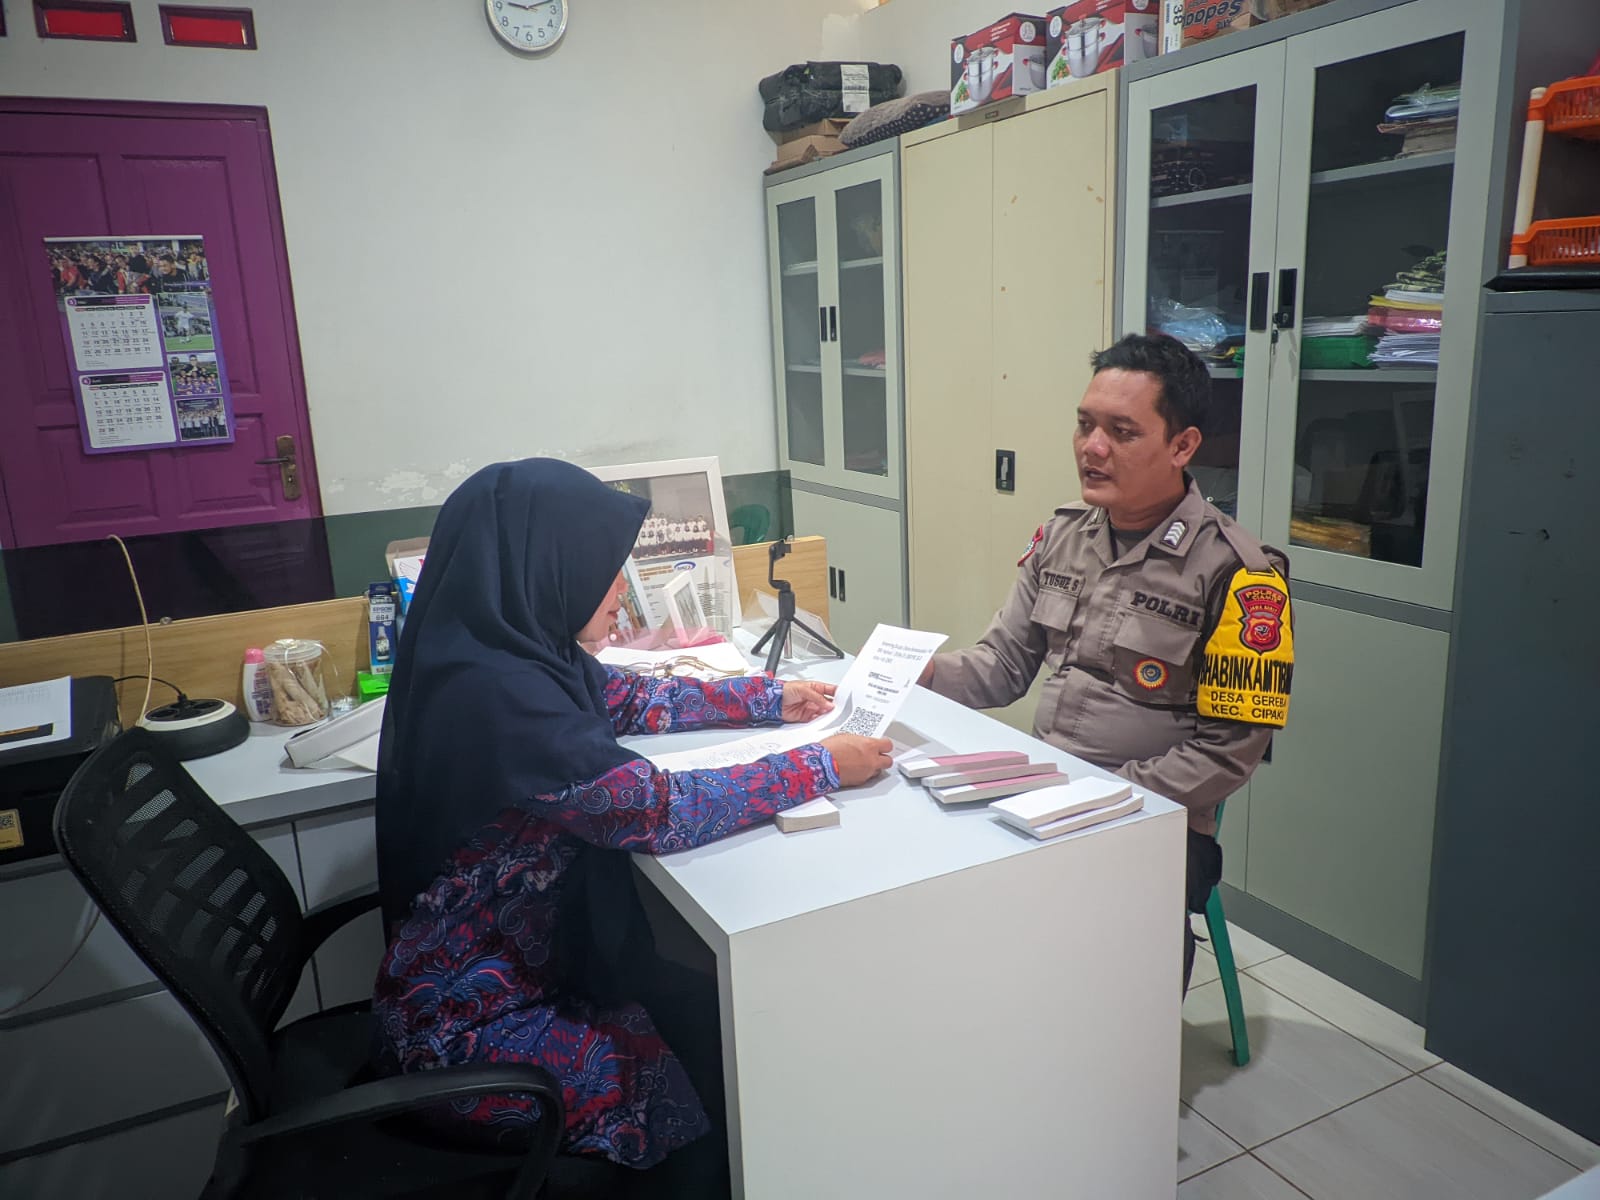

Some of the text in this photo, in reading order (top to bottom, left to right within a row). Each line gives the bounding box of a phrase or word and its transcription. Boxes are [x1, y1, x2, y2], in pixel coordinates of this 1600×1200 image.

[496, 0, 502, 10] 9
[550, 5, 557, 15] 3
[1173, 4, 1182, 26] 38
[502, 16, 509, 26] 8
[547, 18, 554, 28] 4
[513, 26, 520, 37] 7
[538, 28, 545, 38] 5
[526, 32, 533, 42] 6
[1072, 579, 1079, 591] S
[1130, 590, 1200, 626] POLRI
[1210, 691, 1244, 704] DESA
[1211, 704, 1243, 716] KEC.
